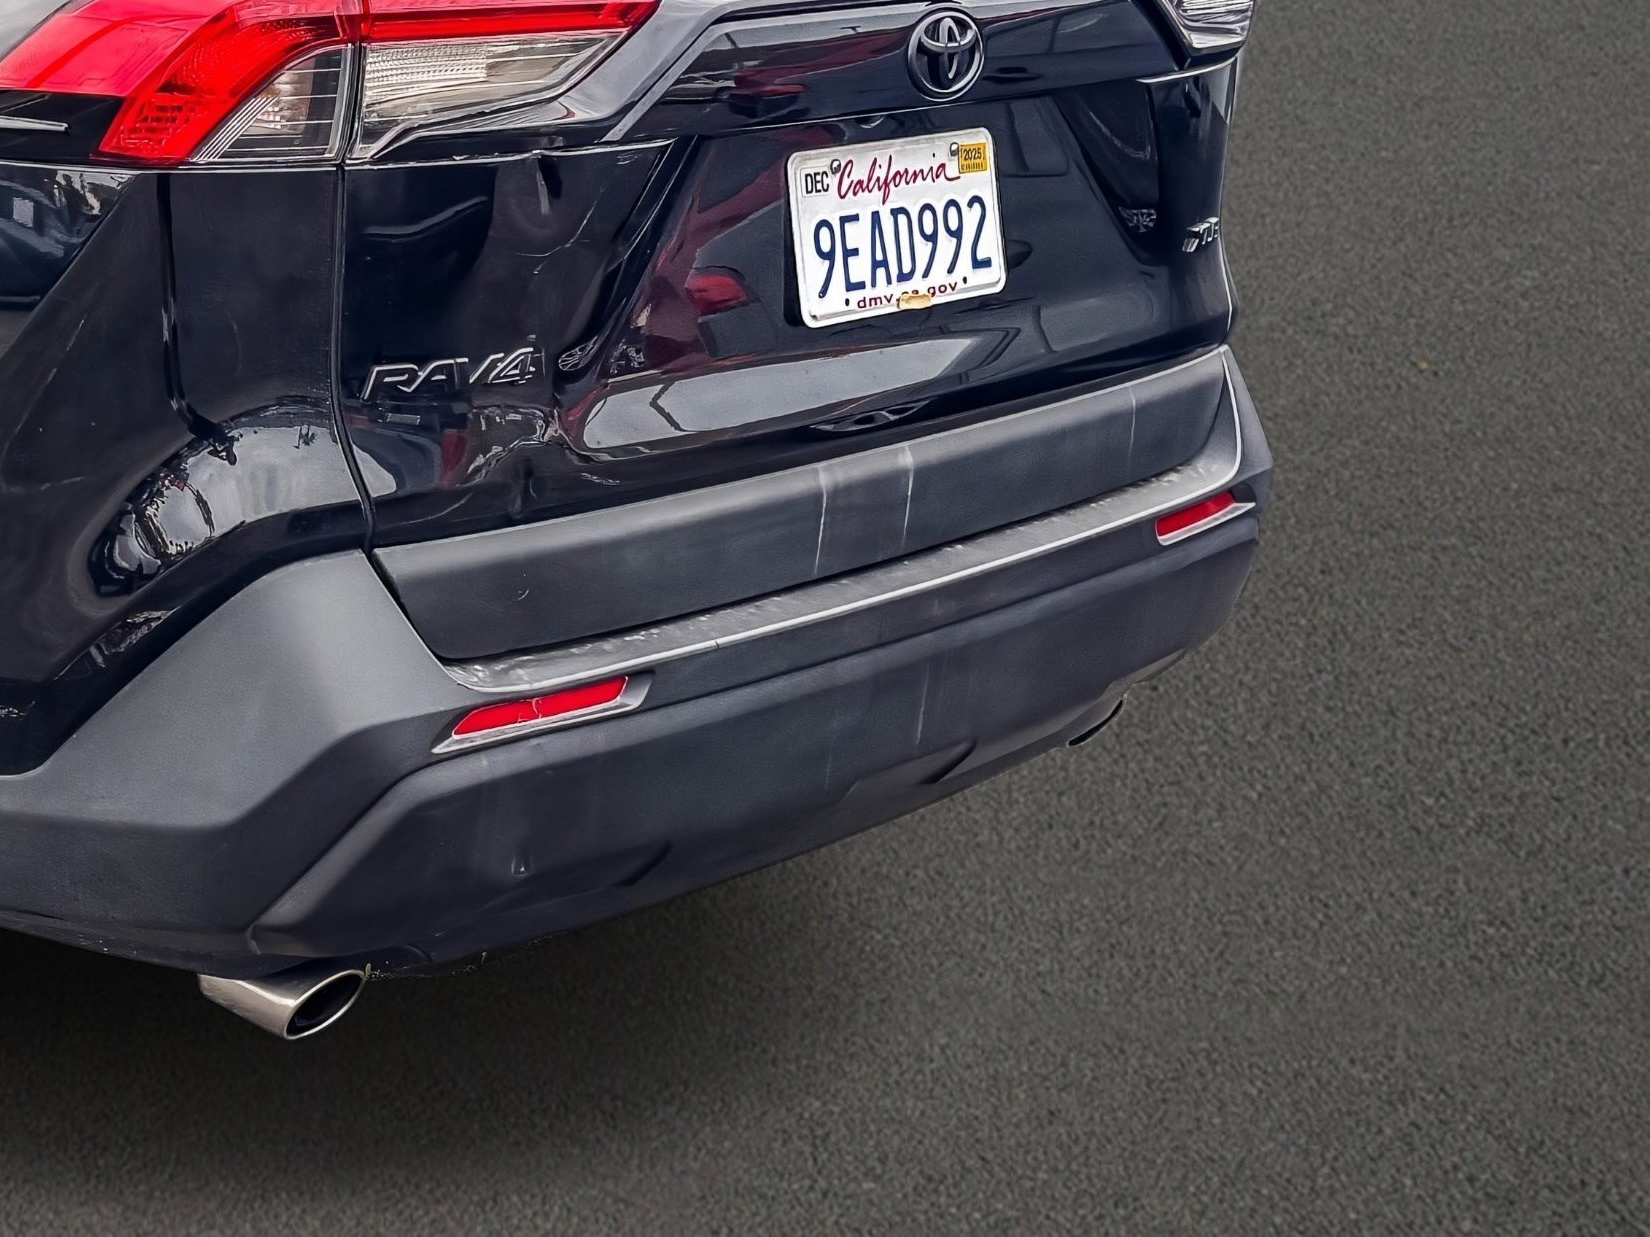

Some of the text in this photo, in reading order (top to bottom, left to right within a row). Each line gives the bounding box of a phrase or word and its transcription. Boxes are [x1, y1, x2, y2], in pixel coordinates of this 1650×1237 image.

[805, 148, 982, 205] DEC California 2025
[814, 195, 992, 299] 9EAD992
[857, 282, 958, 309] dmvagov
[360, 347, 539, 401] RAV4
